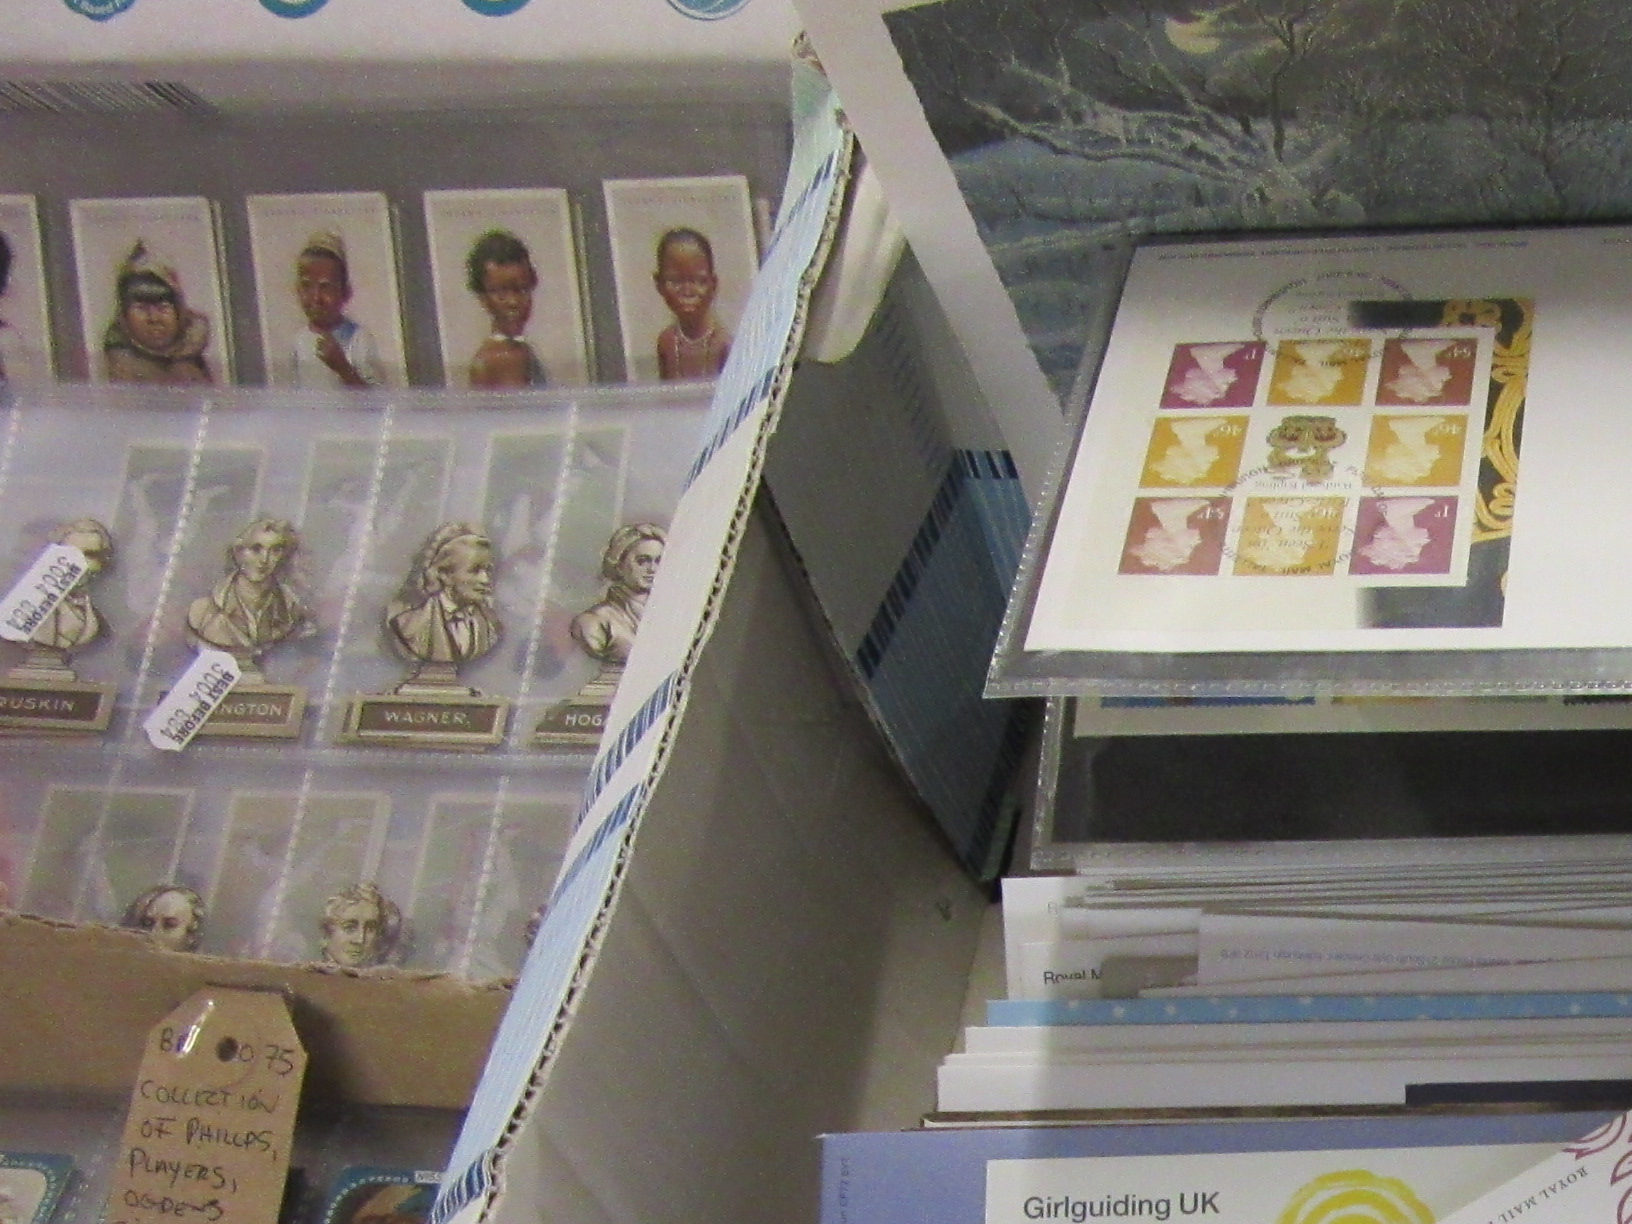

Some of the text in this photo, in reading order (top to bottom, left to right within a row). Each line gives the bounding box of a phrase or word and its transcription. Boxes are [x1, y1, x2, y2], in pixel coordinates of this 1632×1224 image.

[171, 670, 236, 744] BEST BEFORE
[1538, 1165, 1589, 1201] ROYAL
[1179, 1191, 1221, 1215] UK
[1498, 1195, 1538, 1224] MAIL
